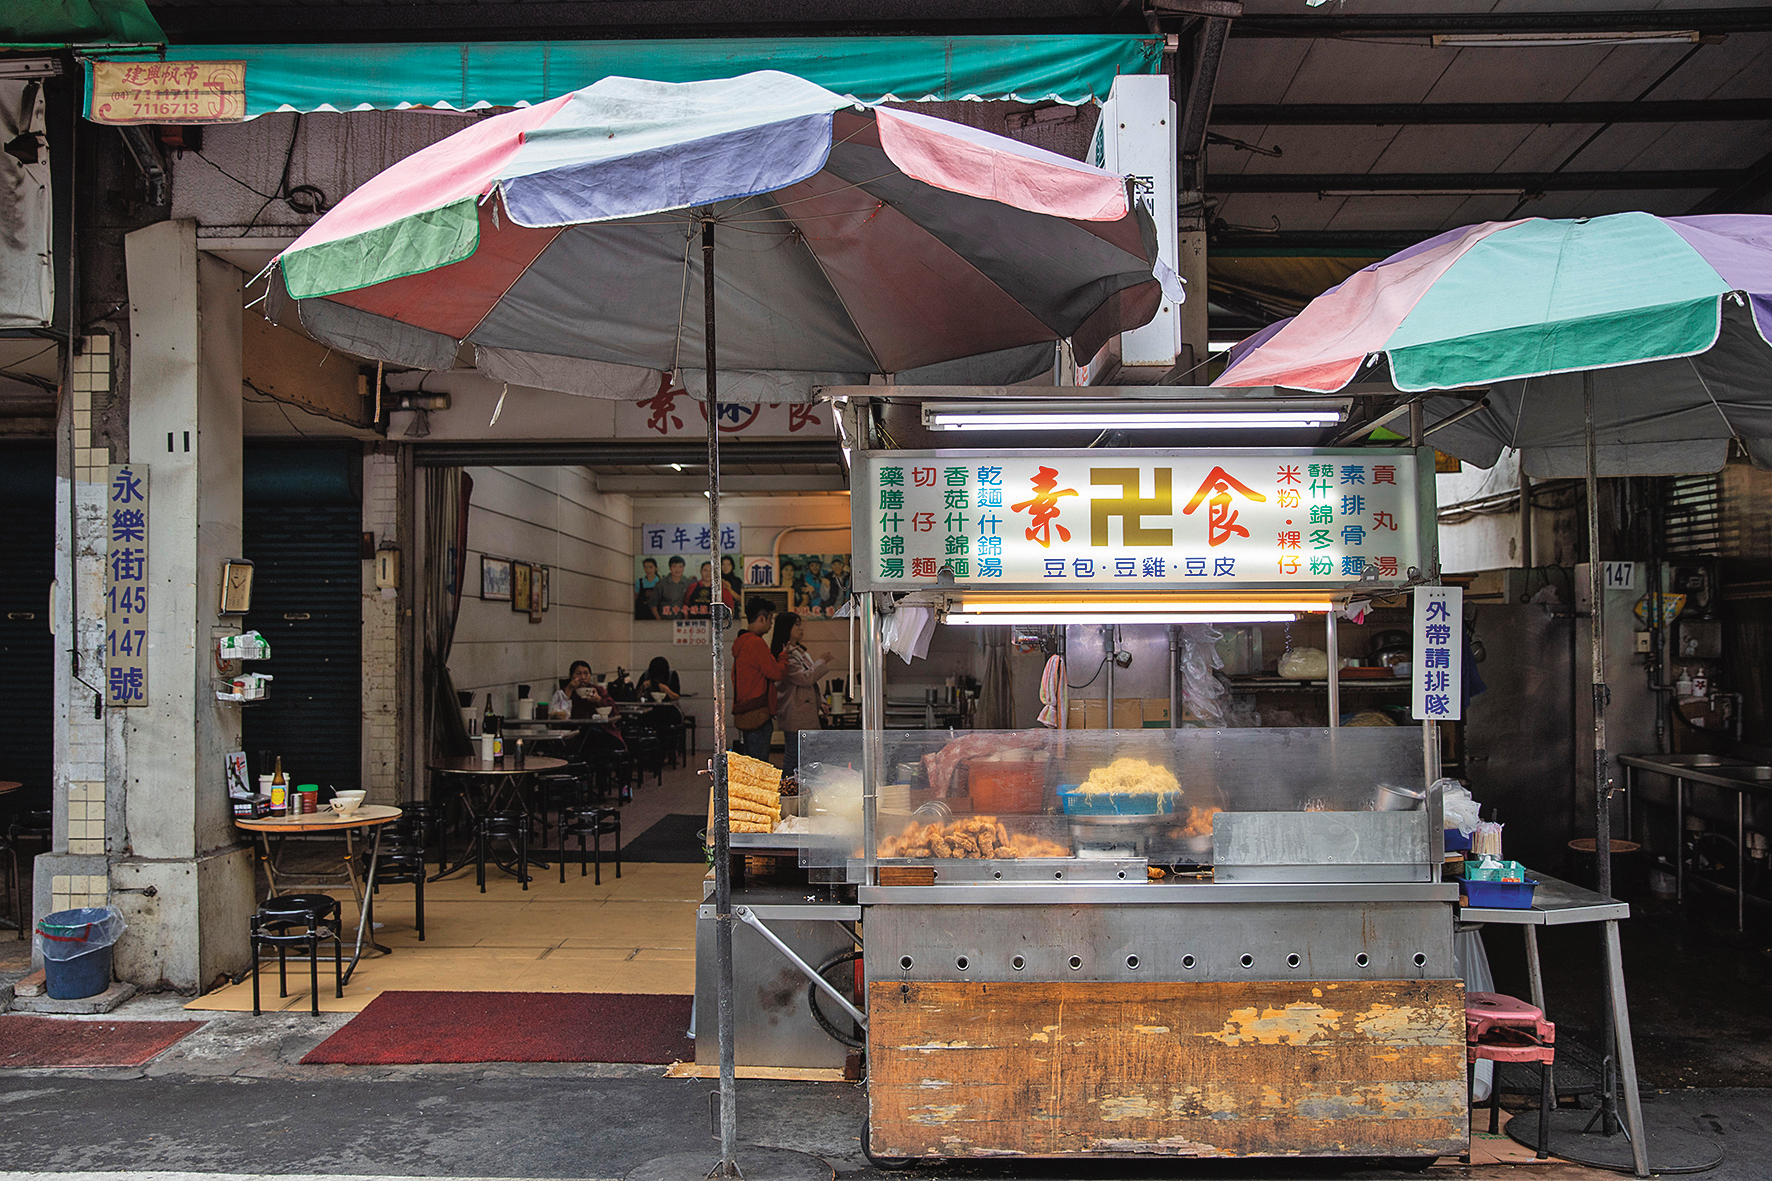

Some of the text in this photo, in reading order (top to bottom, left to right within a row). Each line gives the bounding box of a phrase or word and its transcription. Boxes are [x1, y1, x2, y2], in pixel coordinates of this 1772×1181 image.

[122, 64, 200, 87] 建興帆布
[132, 103, 199, 115] 7116713
[648, 527, 736, 551] 百年老店
[751, 564, 773, 586] 林
[879, 466, 905, 579] 藥膳什錦湯
[911, 466, 938, 578] 切仔麵
[943, 466, 970, 579] 香菇什錦麵
[1340, 464, 1366, 577] 素排骨麵
[1371, 464, 1398, 577] 貢丸湯
[1606, 563, 1632, 586] 147
[1424, 600, 1451, 715] 外帶請排隊
